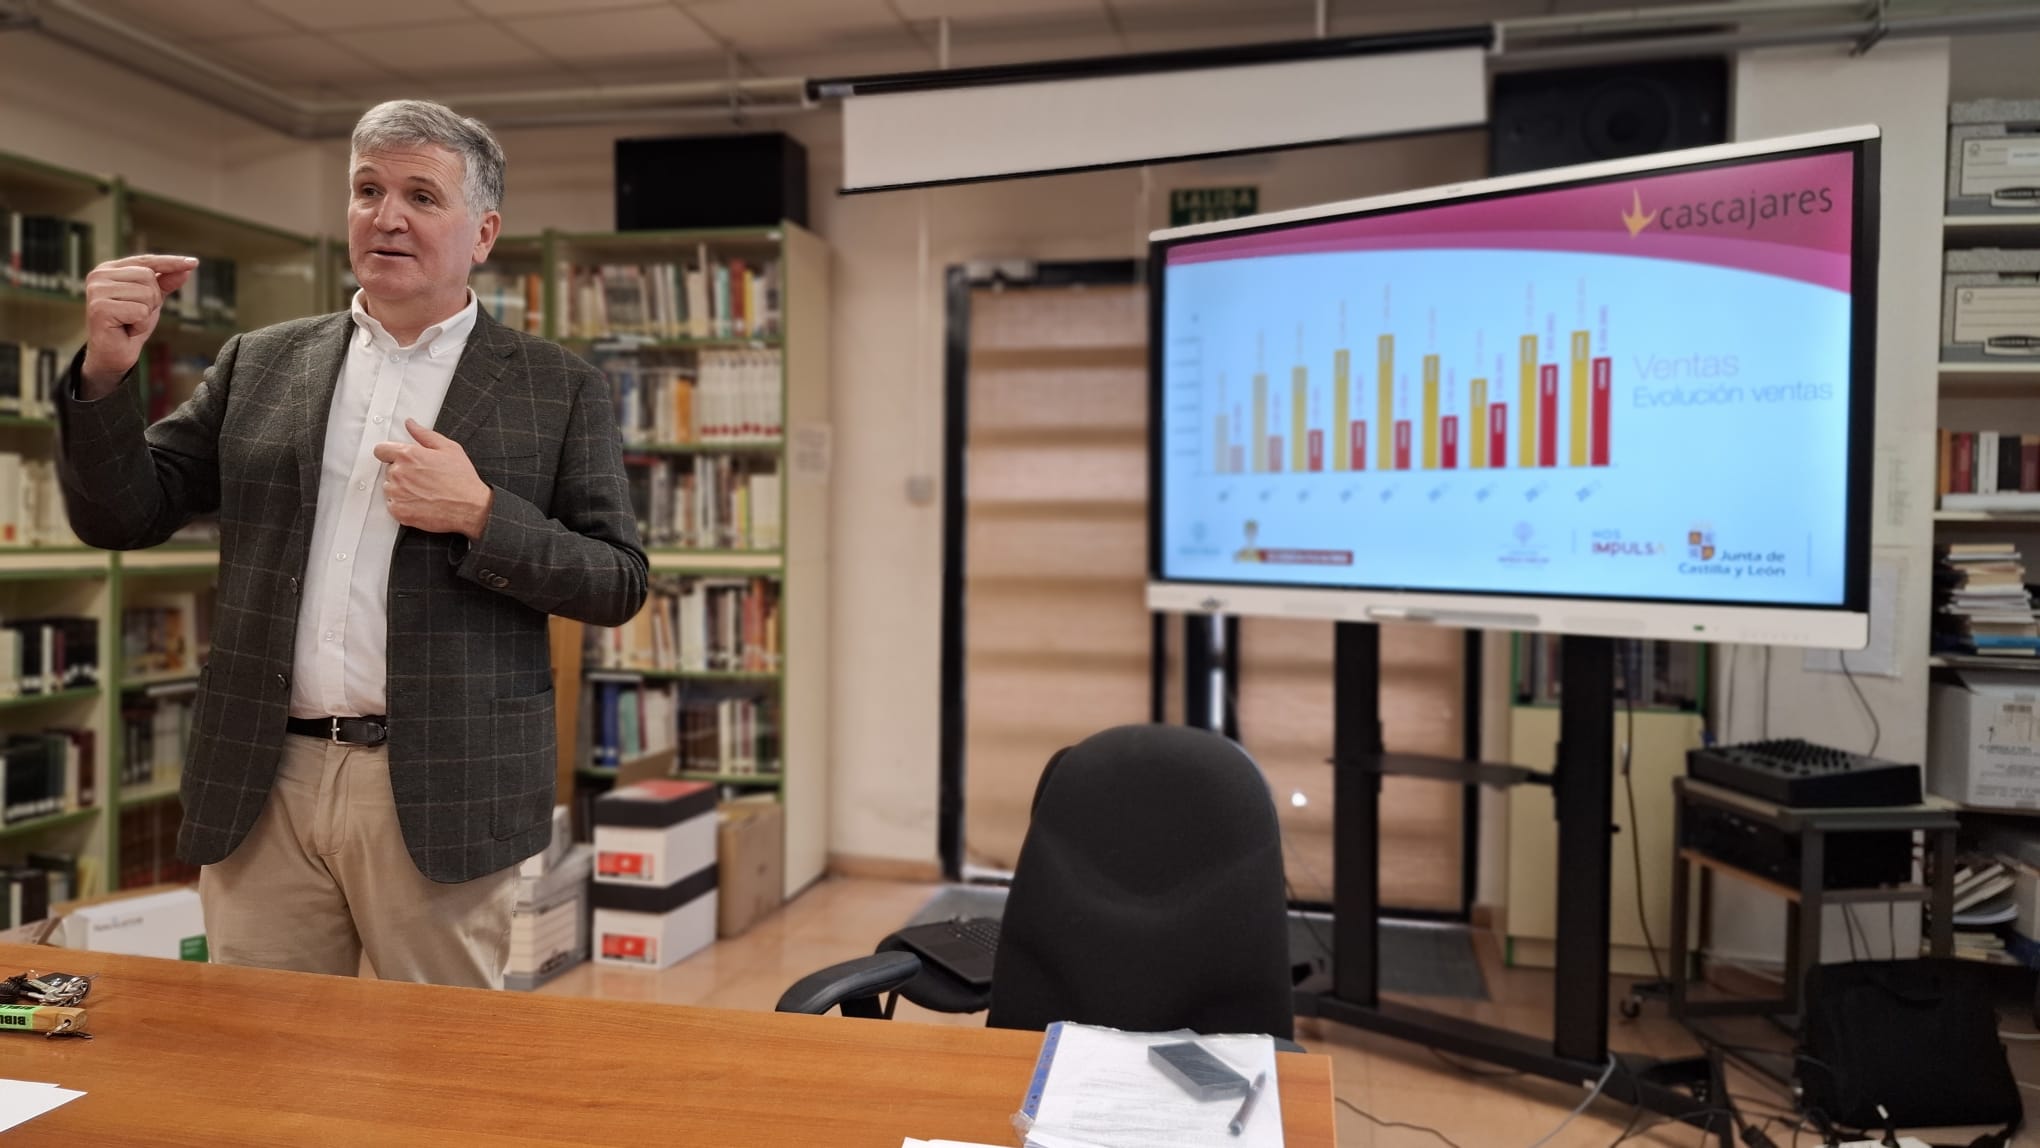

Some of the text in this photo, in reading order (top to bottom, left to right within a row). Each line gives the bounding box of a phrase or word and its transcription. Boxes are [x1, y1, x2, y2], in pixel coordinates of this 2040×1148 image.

[1659, 187, 1833, 231] cascajares
[1633, 352, 1740, 381] Ventas
[1632, 381, 1834, 408] Evolución ventas
[1678, 561, 1732, 576] Castilla
[1747, 564, 1787, 578] León
[1720, 550, 1786, 563] Junta de
